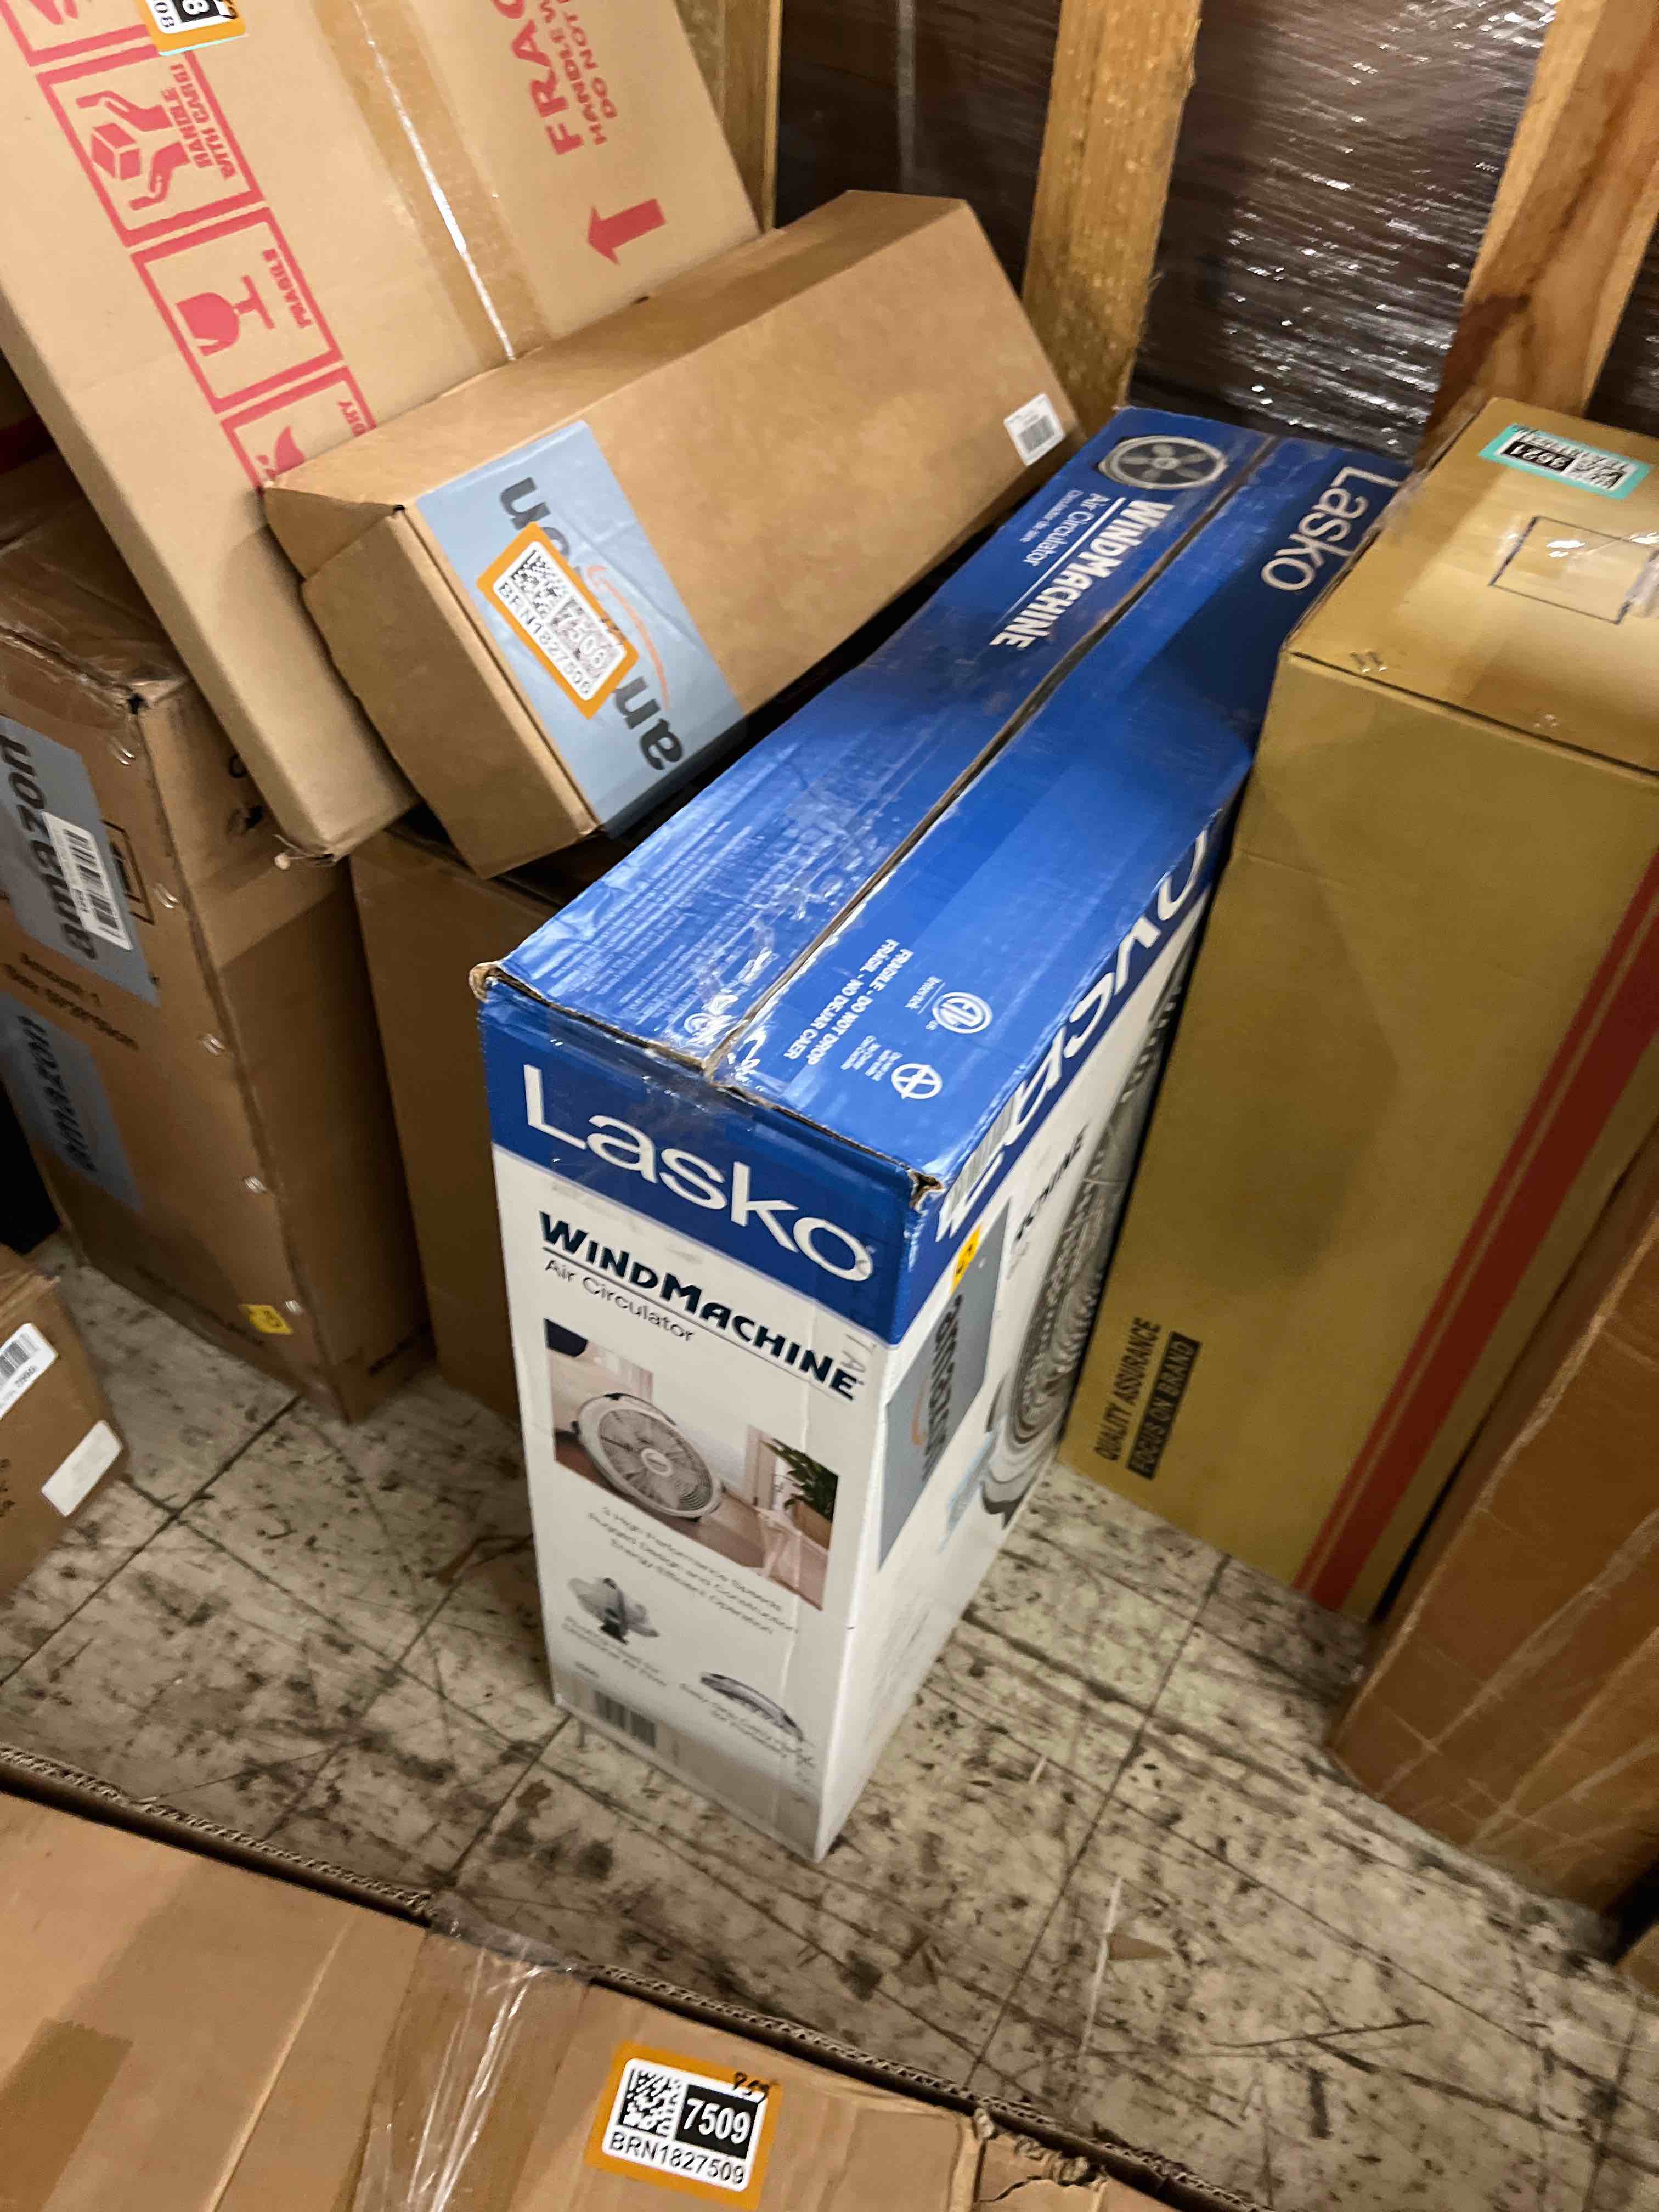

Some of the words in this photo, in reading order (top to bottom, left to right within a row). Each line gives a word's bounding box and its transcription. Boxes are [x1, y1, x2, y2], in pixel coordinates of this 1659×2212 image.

[562, 11, 599, 70] NOT
[550, 27, 607, 145] HANDLE
[591, 76, 618, 119] DO
[161, 87, 213, 168] HANDLE
[201, 127, 236, 180] WITH
[262, 247, 313, 328] FRAGILE
[1079, 493, 1111, 511] Air
[1261, 466, 1403, 592] Lasko
[1022, 511, 1095, 567] Circulator
[990, 499, 1175, 650] WINDMACHINE
[841, 978, 865, 996] NO
[869, 948, 914, 992] FRAGILE
[810, 994, 850, 1030] DEJAR
[831, 1011, 860, 1036] NOT
[851, 995, 874, 1013] DO
[783, 1028, 819, 1060] CAER
[806, 1032, 840, 1065] DROP
[523, 1063, 874, 1283] Lasko
[538, 1210, 856, 1402] WINDMACHINE
[544, 1257, 576, 1283] Air
[582, 1276, 695, 1342] Circulator
[1111, 1316, 1163, 1406] ASSURANCE
[1156, 1340, 1196, 1397] BRAND
[1093, 1401, 1132, 1462] QUALITY
[684, 2097, 752, 2145] 7509
[609, 2131, 744, 2185] BRN1827509
